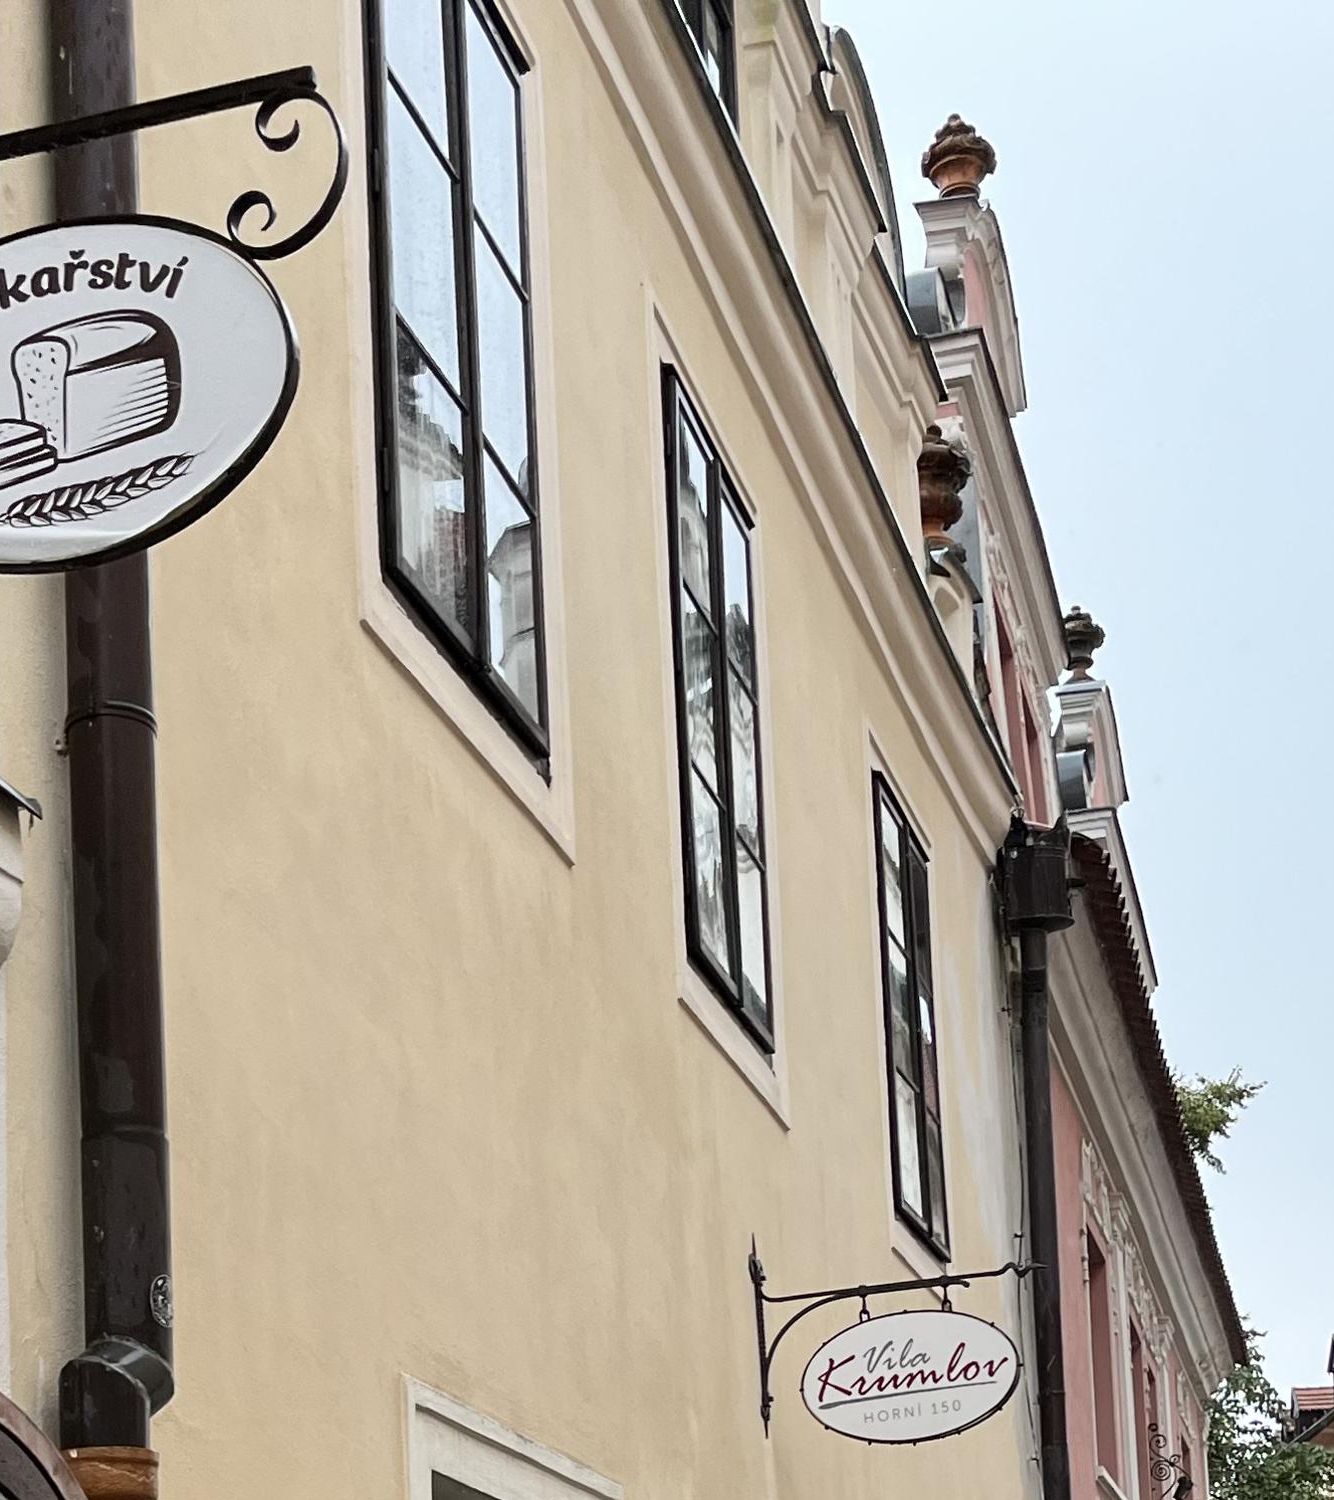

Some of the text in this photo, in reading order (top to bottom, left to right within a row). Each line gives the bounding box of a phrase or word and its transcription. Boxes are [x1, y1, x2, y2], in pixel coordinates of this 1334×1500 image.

[817, 1342, 1009, 1403] Krumlov
[864, 1338, 930, 1374] Vila
[864, 1399, 962, 1424] HORNÍ 150
